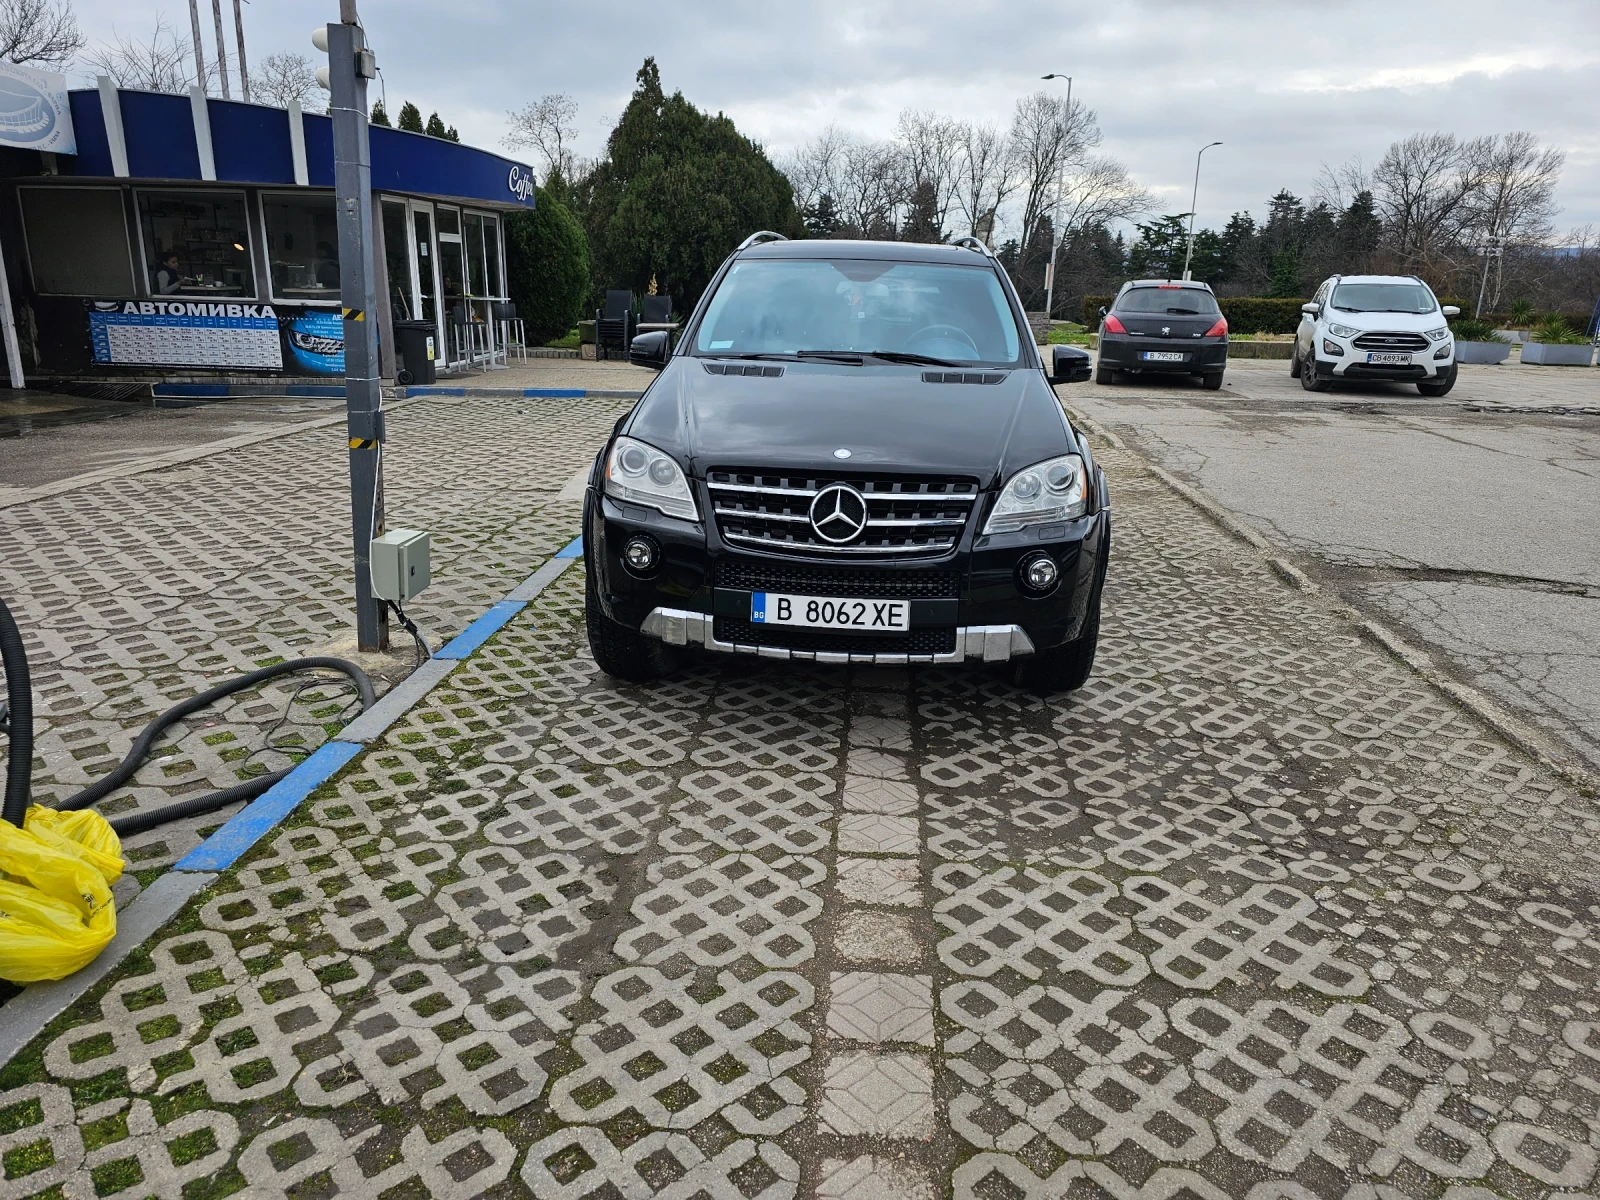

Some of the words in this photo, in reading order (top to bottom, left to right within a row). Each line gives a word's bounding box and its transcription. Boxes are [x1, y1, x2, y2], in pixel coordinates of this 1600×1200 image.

[509, 166, 533, 200] Coffee
[123, 301, 278, 319] АВТОМИВКА
[1157, 352, 1172, 360] 7952
[754, 611, 764, 619] BG
[777, 597, 792, 621] B
[805, 600, 867, 625] 8062
[871, 602, 904, 627] XE
